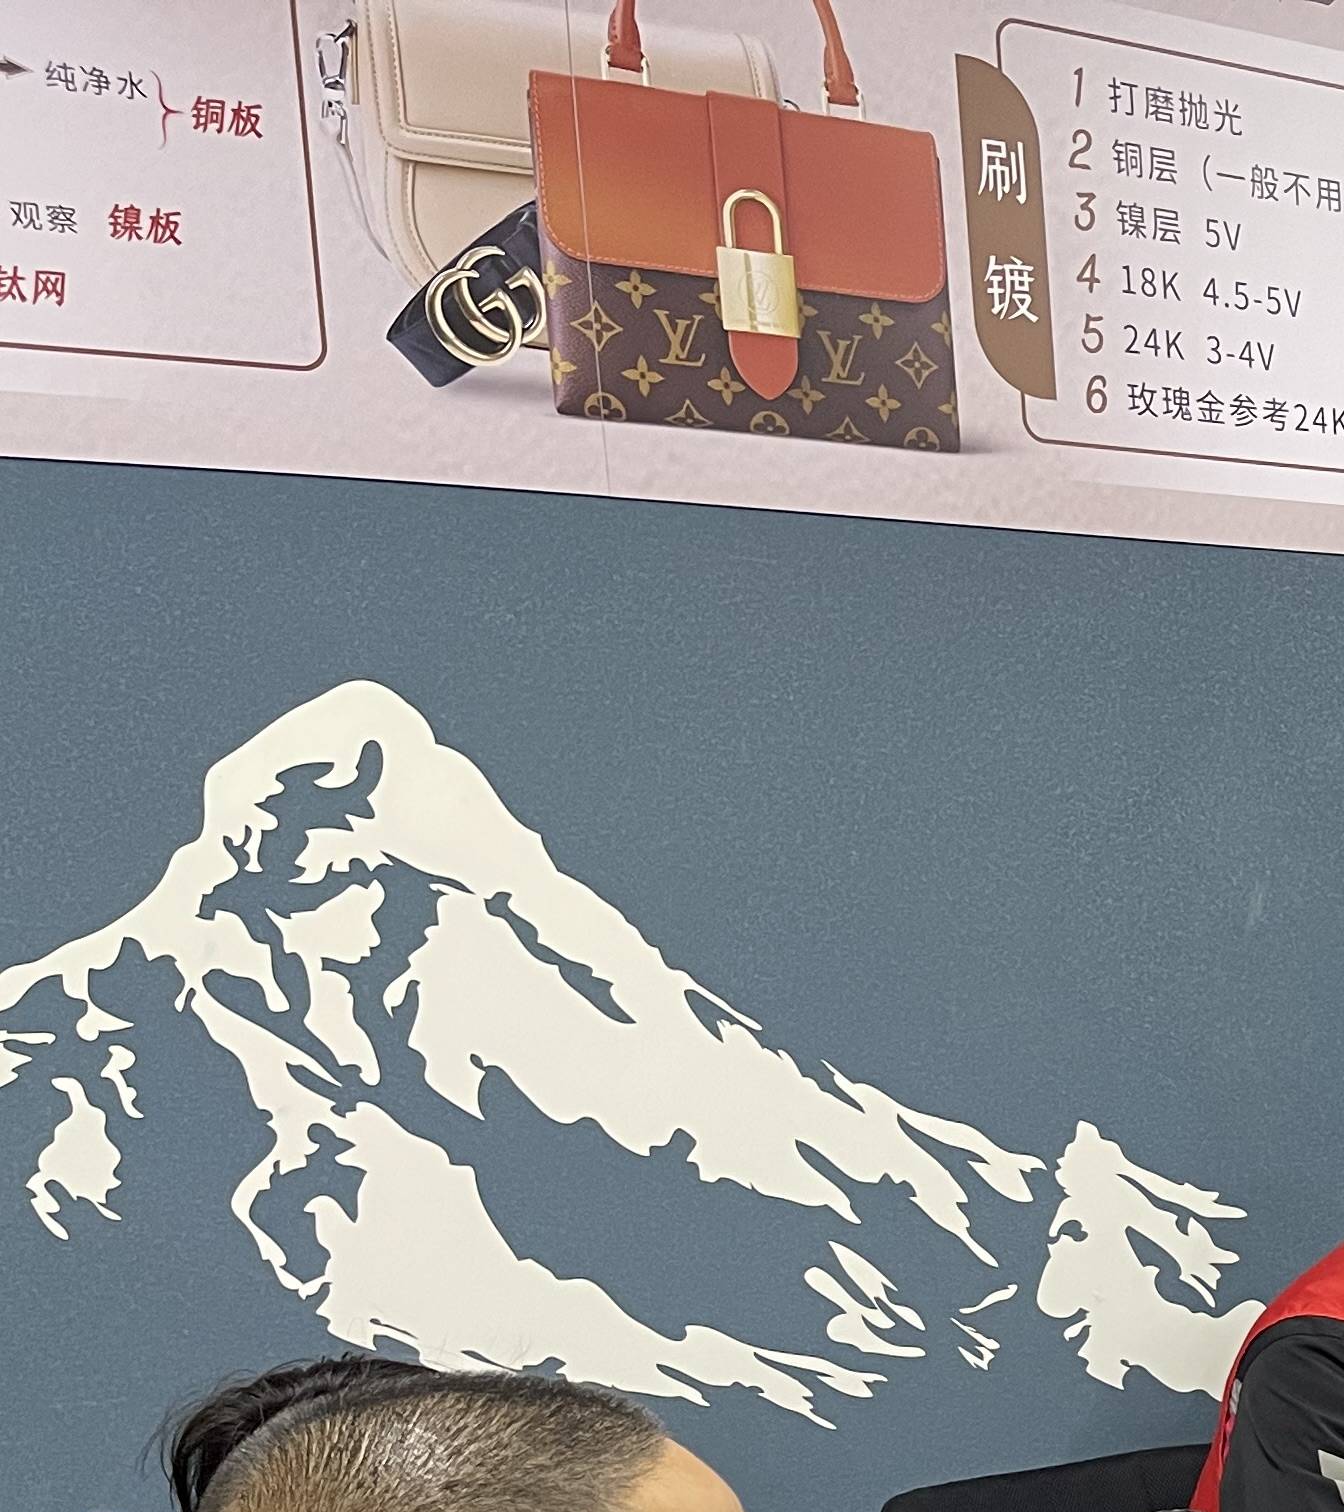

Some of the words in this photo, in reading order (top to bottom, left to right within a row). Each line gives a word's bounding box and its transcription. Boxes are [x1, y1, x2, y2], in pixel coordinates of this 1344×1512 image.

[44, 60, 148, 102] 纯净水
[1071, 67, 1085, 109] 1
[1107, 78, 1244, 138] 打磨抛光
[191, 95, 264, 141] 铜板
[1068, 129, 1093, 171] 2
[11, 201, 79, 237] 观察
[107, 204, 184, 246] 镍板
[1073, 191, 1097, 232] 3
[1116, 201, 1182, 247] 镍层
[1204, 217, 1243, 251] 5V
[1075, 253, 1101, 294] 4
[1121, 265, 1182, 302] 18K
[1203, 279, 1302, 318] 4.5-5V
[1081, 313, 1104, 354] 5
[1123, 324, 1186, 361] 24K
[1206, 334, 1276, 372] 3-4V
[1085, 374, 1108, 415] 6
